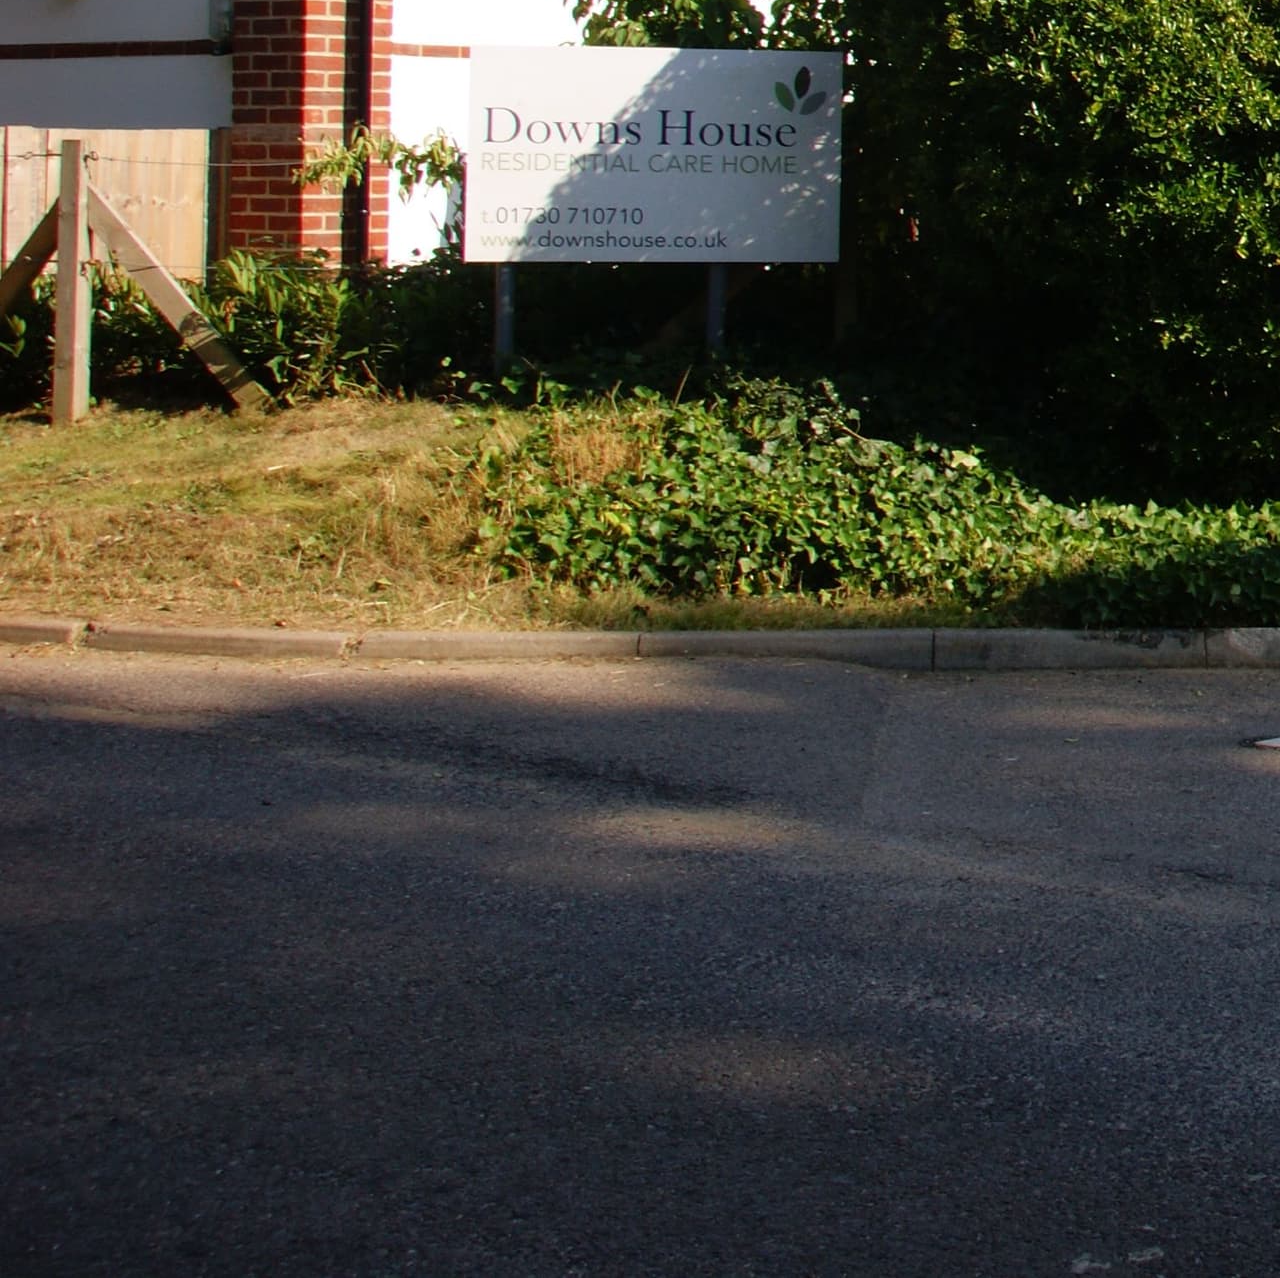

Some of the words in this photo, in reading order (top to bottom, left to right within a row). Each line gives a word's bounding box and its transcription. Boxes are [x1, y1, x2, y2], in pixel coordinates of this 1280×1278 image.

[482, 107, 641, 145] Downs
[657, 109, 797, 148] House
[480, 152, 640, 172] RESIDENTIAL
[648, 154, 713, 173] CARE
[722, 155, 797, 174] HOME
[568, 207, 644, 225] 710710
[480, 230, 728, 248] www.downshouse.co.uk
